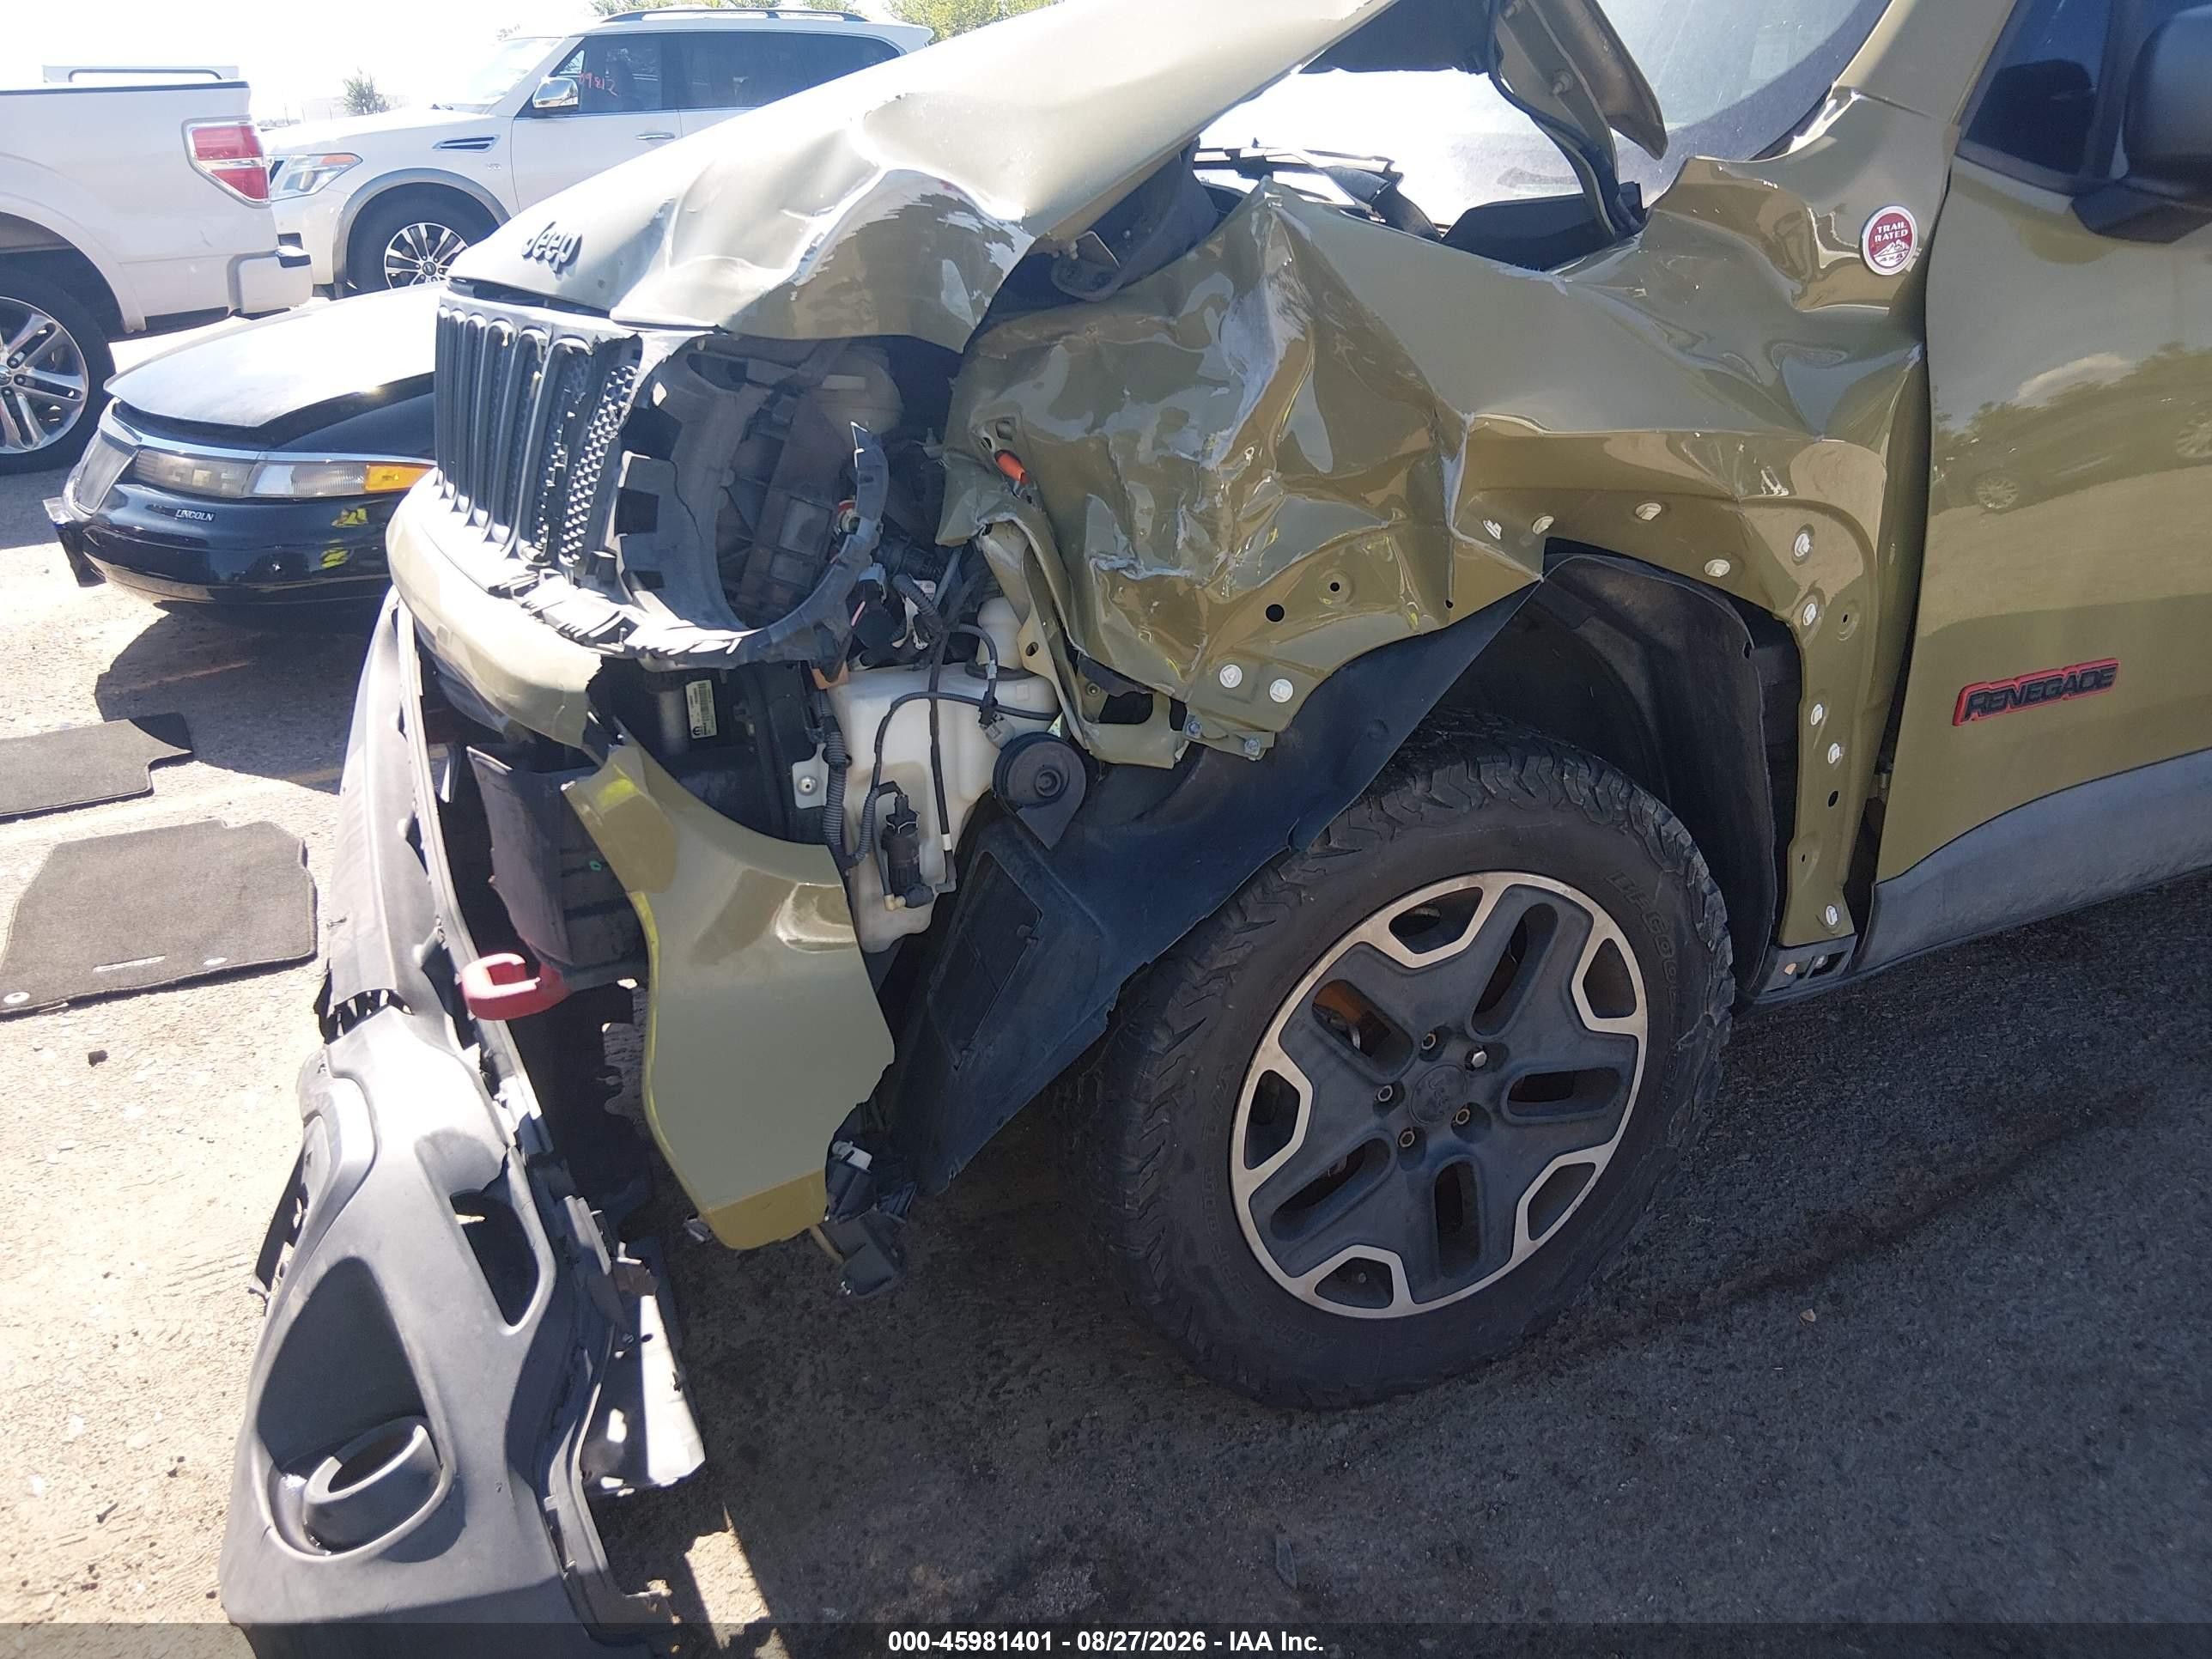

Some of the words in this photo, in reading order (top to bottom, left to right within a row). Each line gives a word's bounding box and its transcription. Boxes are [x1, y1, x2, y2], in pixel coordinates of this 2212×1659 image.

[1876, 221, 1906, 233] TRAIL
[1874, 228, 1908, 242] RATED
[522, 221, 583, 276] Jeep
[175, 508, 215, 521] LINCOLN
[1960, 661, 2118, 724] RENEGADE
